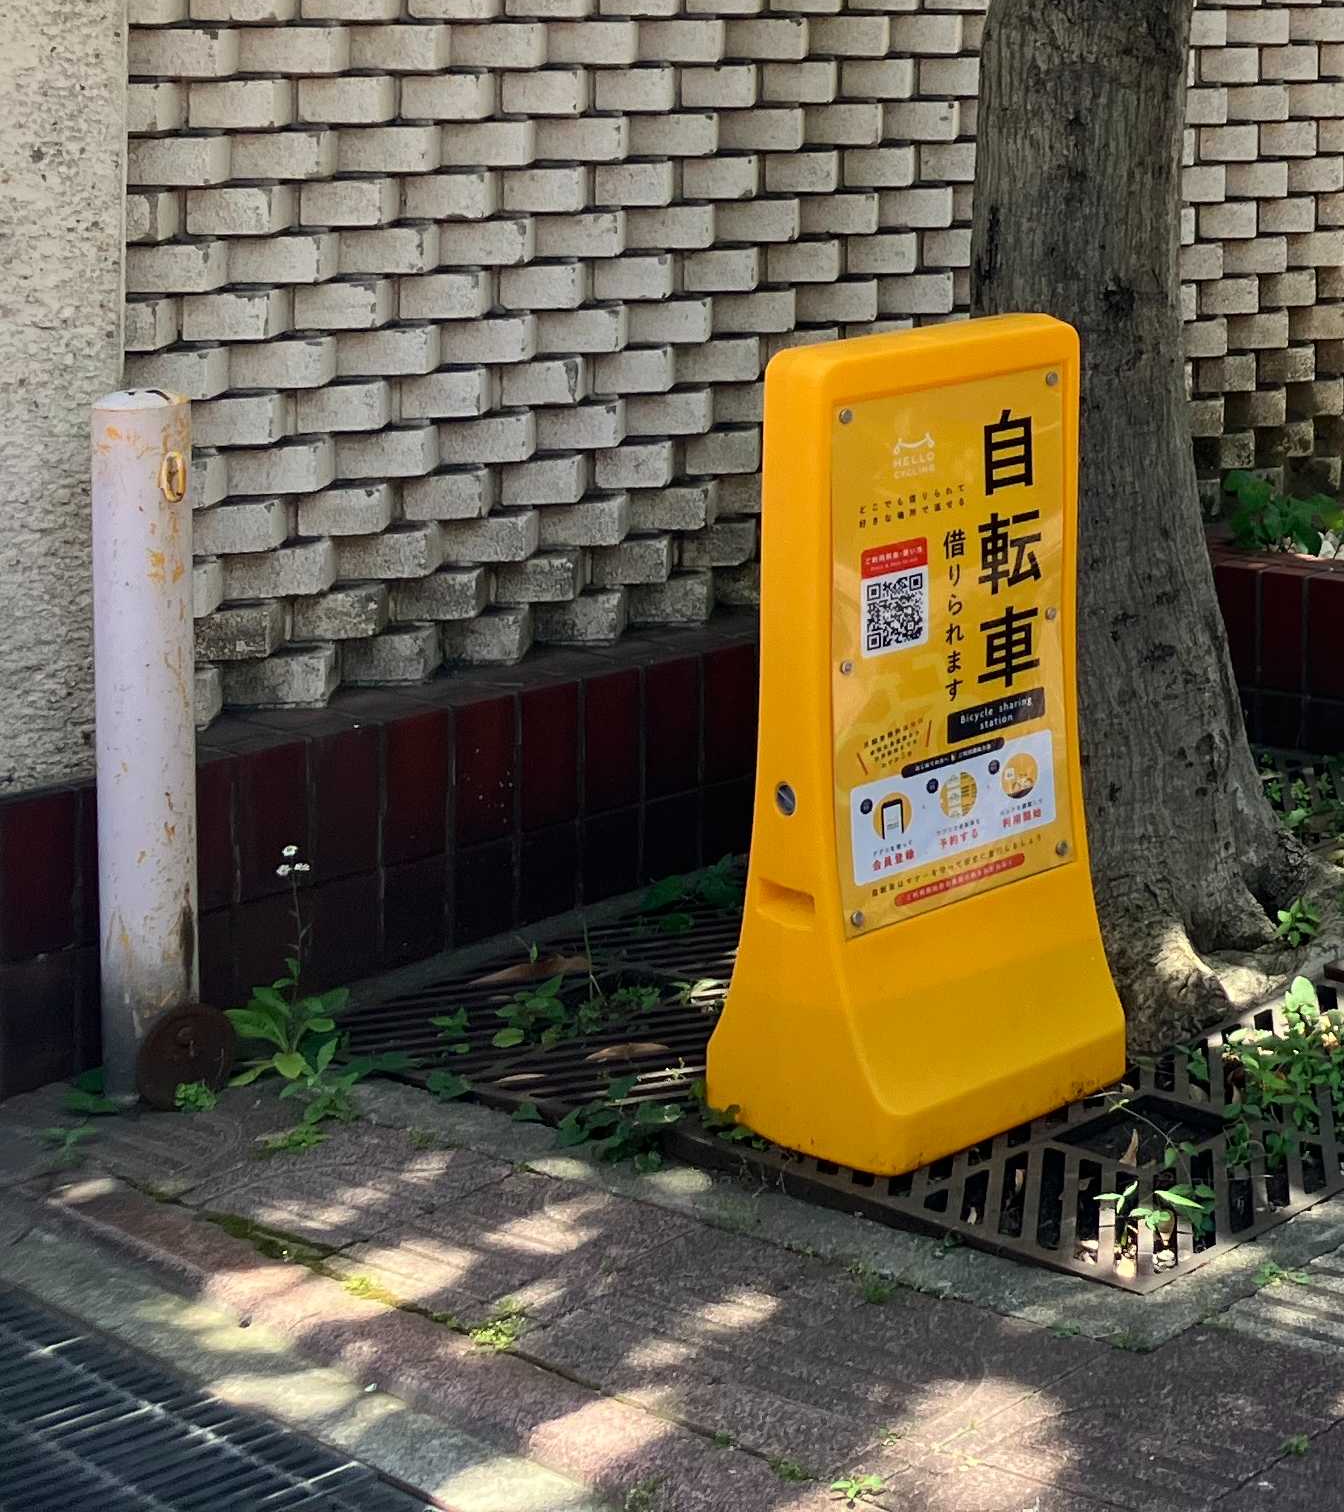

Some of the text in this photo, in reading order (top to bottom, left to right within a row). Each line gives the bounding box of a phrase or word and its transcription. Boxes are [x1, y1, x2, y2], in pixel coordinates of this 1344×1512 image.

[893, 451, 936, 467] HELLO
[977, 408, 1042, 688] 自転車
[943, 528, 967, 702] 借りられます
[960, 696, 1032, 724] Bicycle sharing
[979, 714, 1014, 730] station
